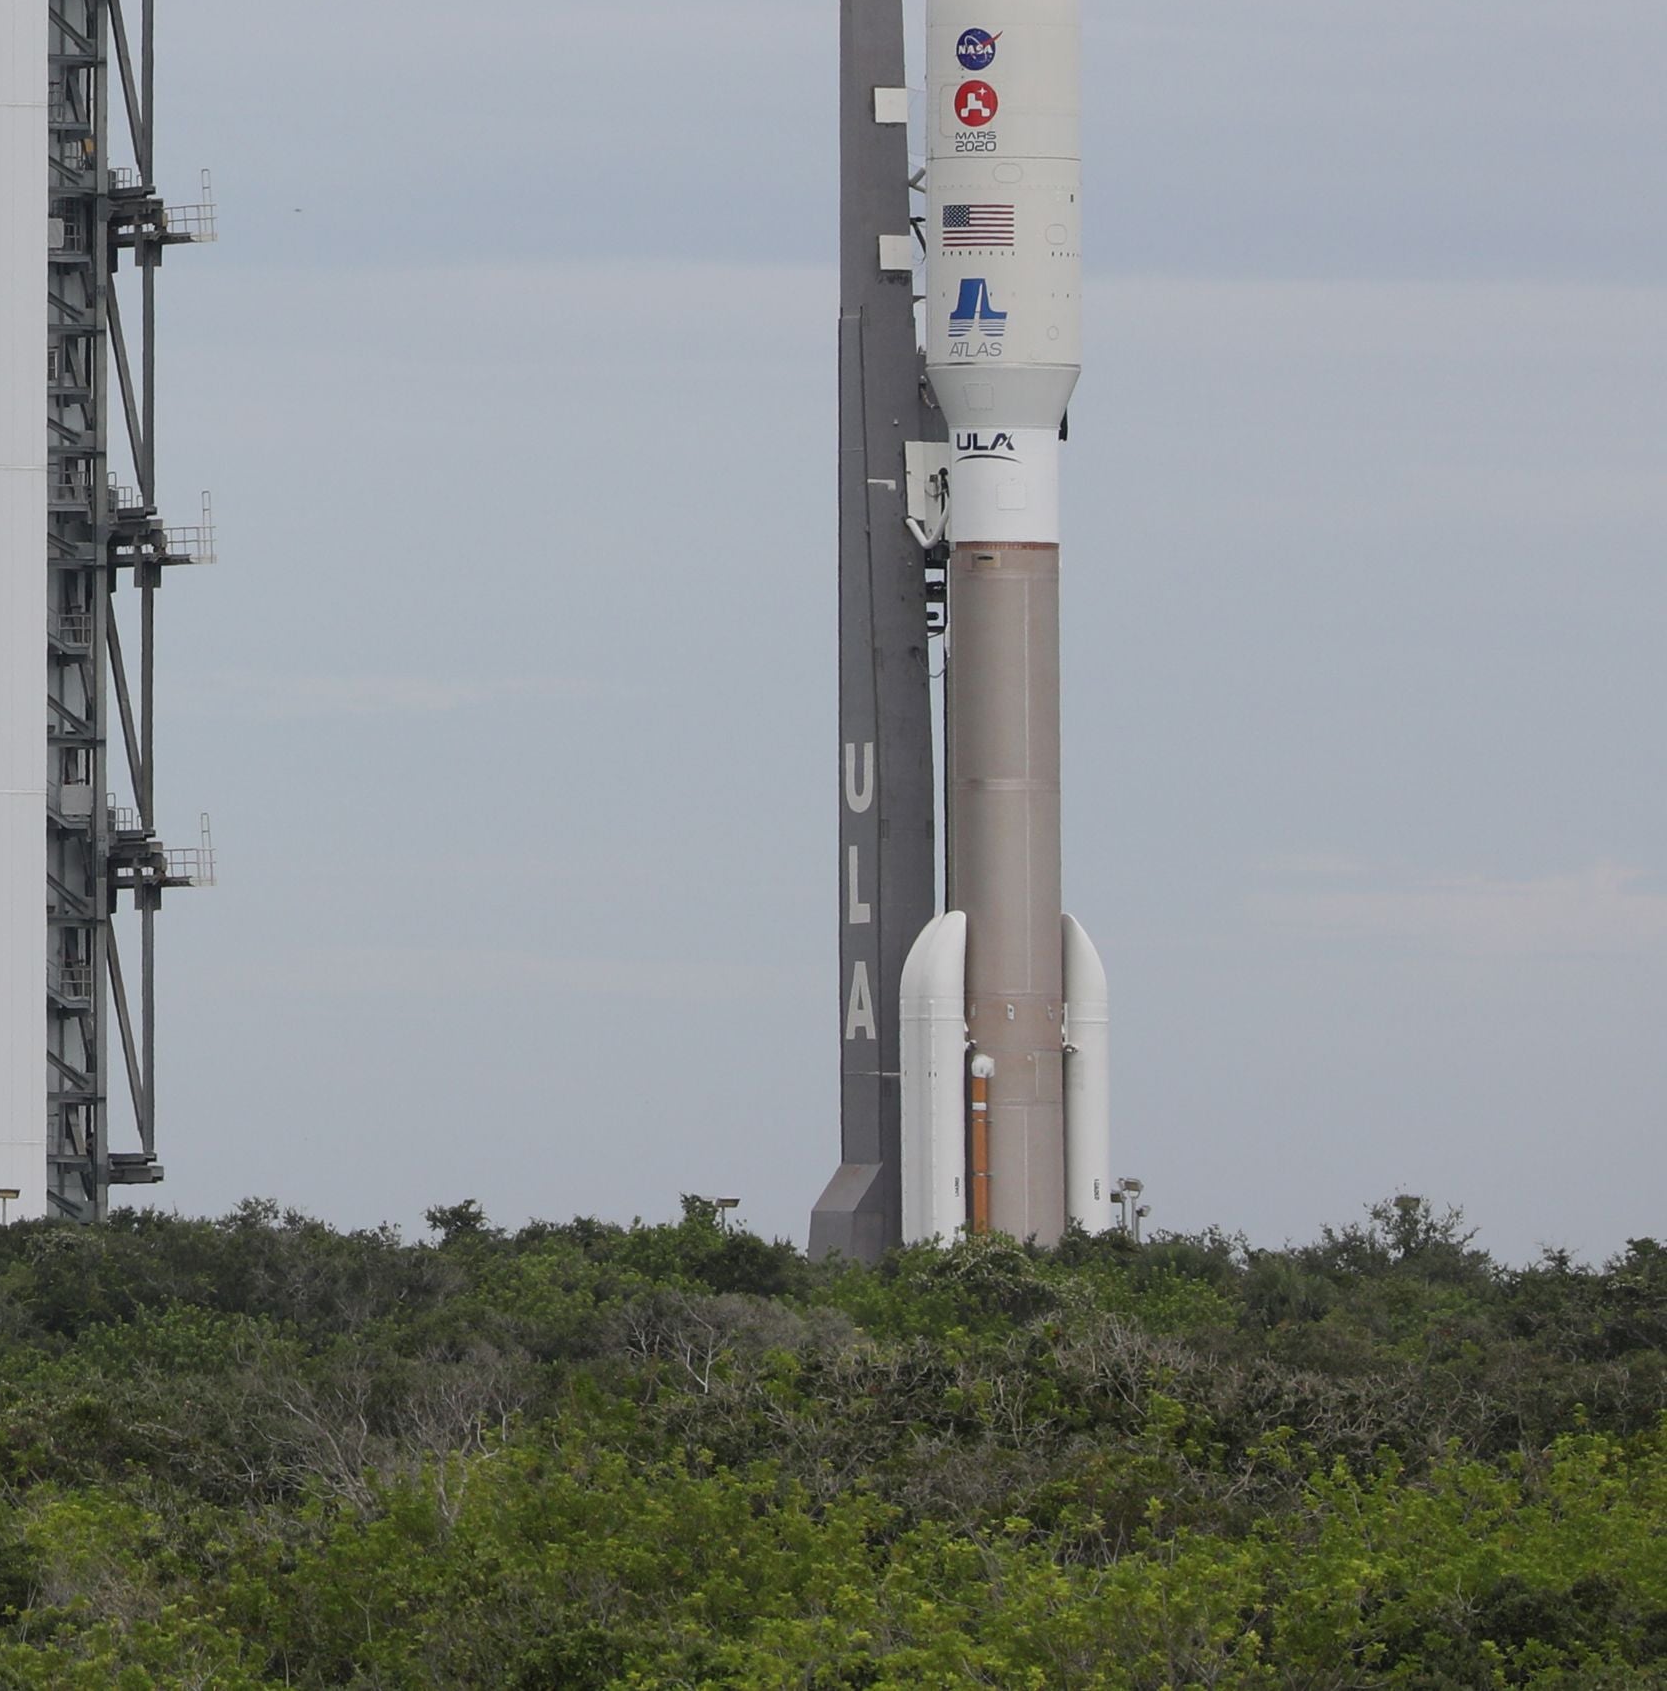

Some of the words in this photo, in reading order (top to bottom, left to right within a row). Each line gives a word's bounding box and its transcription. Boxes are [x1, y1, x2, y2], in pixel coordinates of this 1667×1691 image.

[958, 44, 993, 55] NASA
[955, 131, 997, 140] MARS
[955, 140, 997, 152] 2020
[949, 342, 1003, 357] ATLAS
[956, 432, 1015, 451] ULA
[845, 742, 877, 1040] ULA
